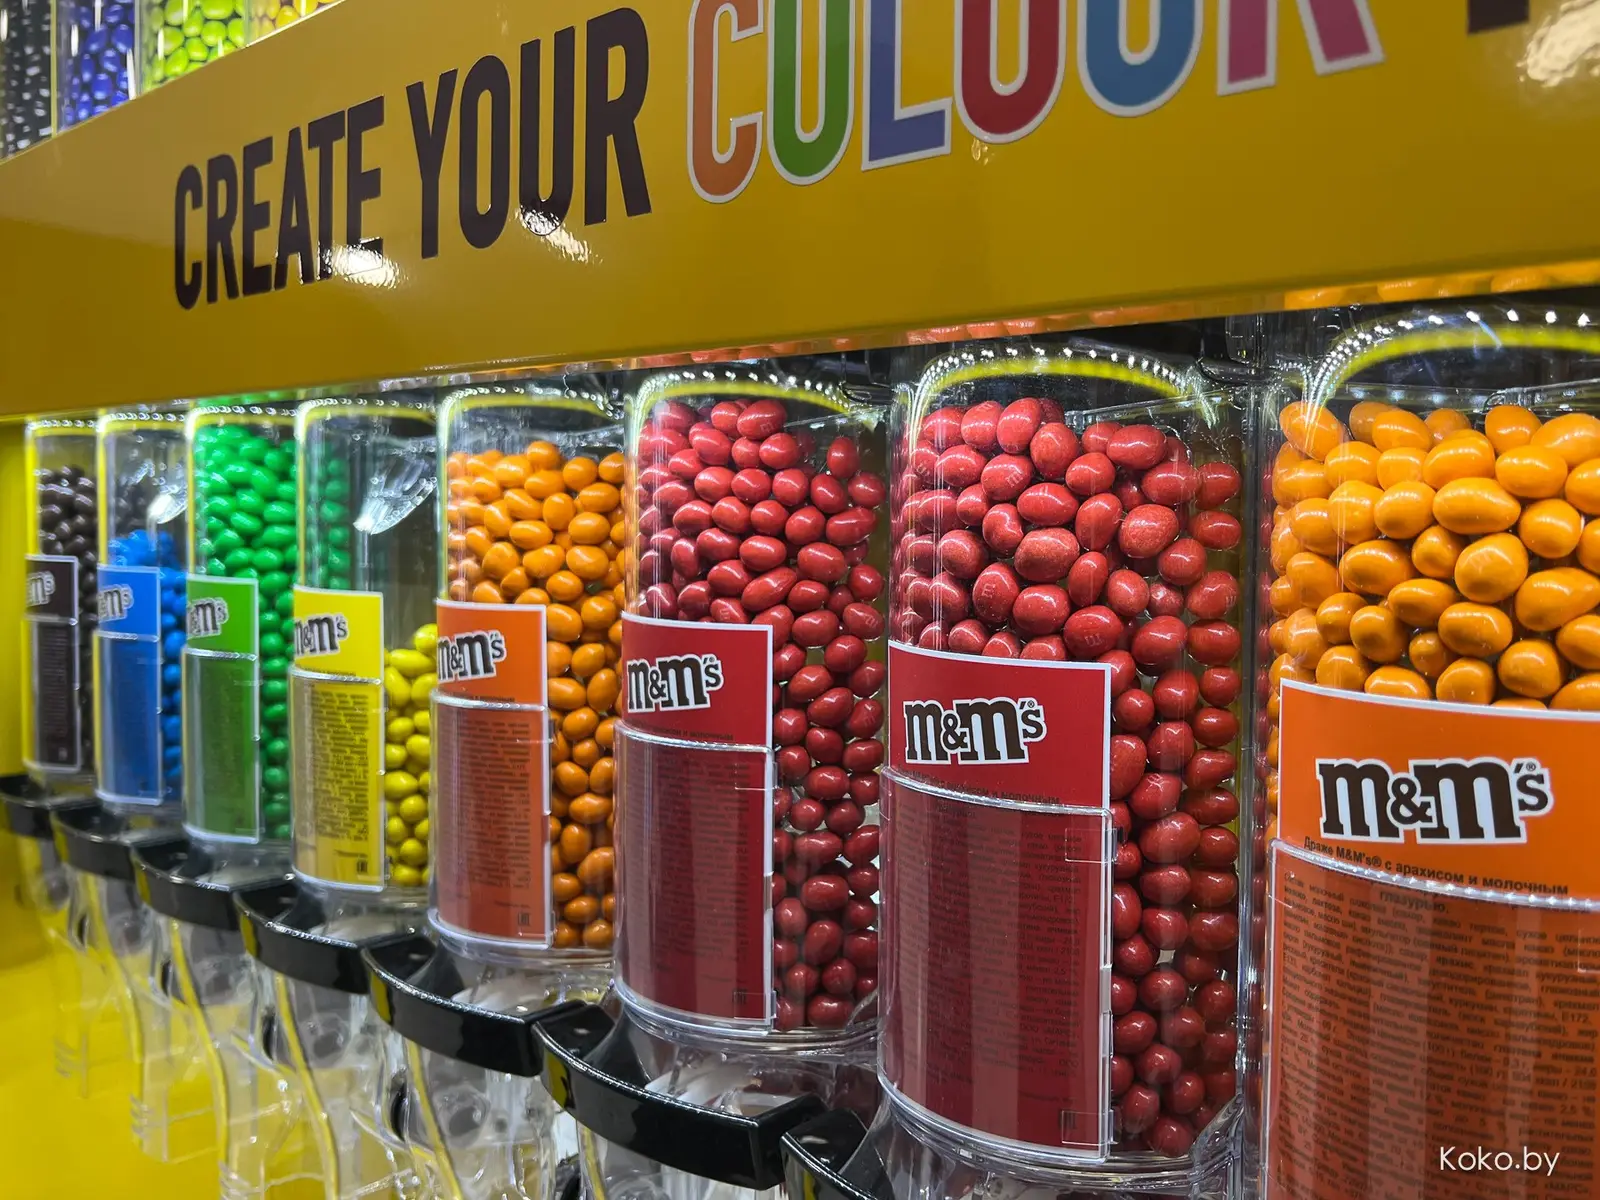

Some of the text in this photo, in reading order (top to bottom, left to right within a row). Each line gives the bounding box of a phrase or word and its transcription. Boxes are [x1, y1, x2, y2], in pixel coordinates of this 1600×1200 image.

[173, 95, 385, 310] CREATE
[406, 7, 652, 259] YOUR
[1303, 836, 1334, 856] Драже
[1384, 862, 1393, 871] с
[1396, 864, 1464, 884] арахисом
[1468, 875, 1478, 886] и
[1482, 877, 1570, 895] молочным
